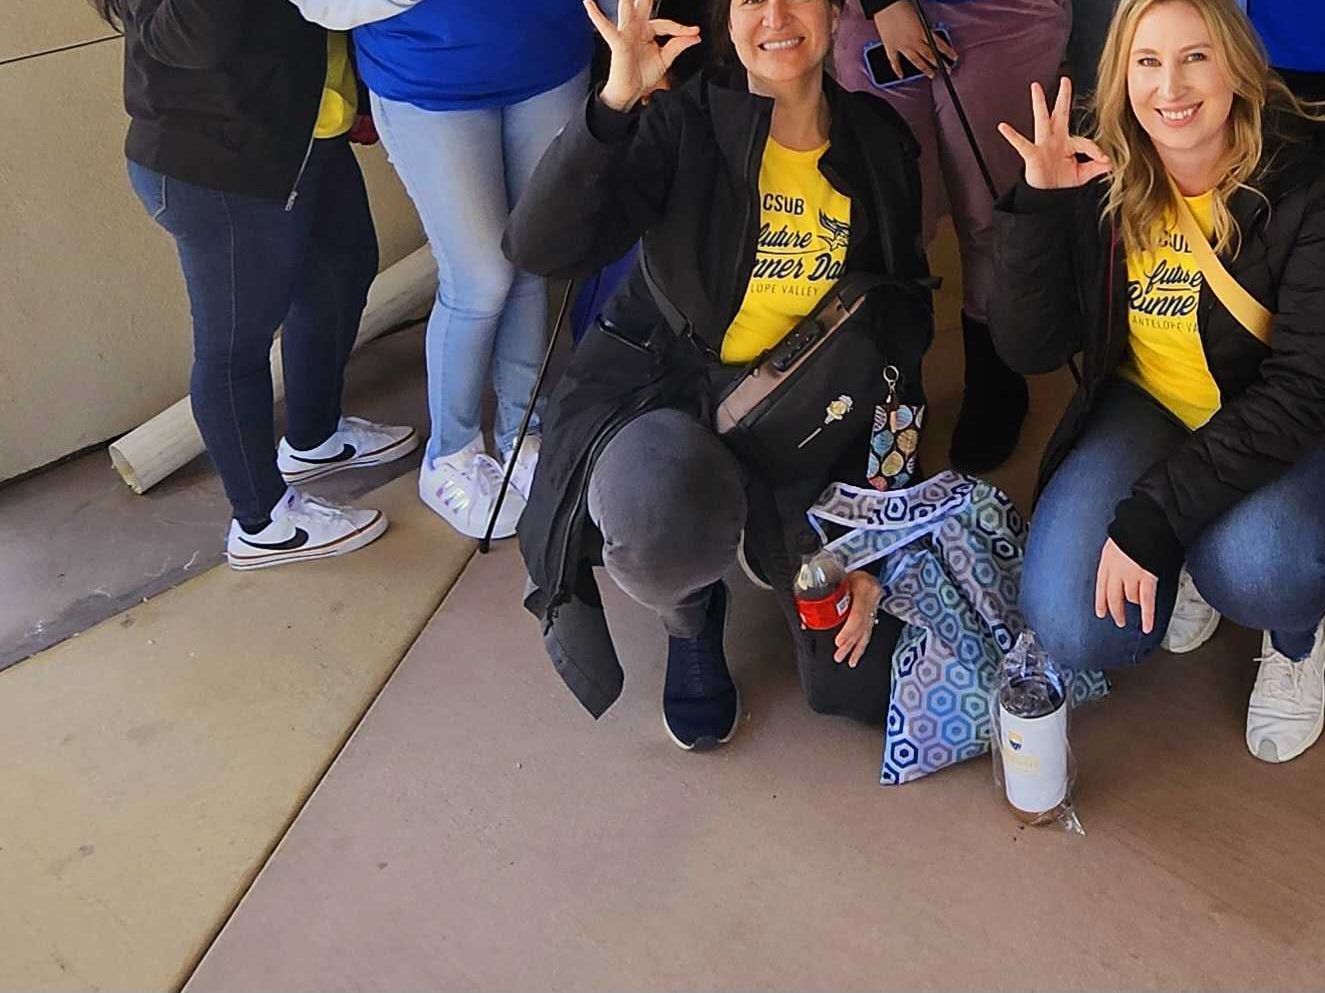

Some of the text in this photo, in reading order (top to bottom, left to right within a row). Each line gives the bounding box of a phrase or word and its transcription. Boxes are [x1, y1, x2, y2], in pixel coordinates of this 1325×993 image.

[763, 193, 805, 216] CSUB
[752, 256, 805, 279] nner
[750, 284, 819, 297] LOPE VALLEY
[1128, 280, 1198, 317] Runne
